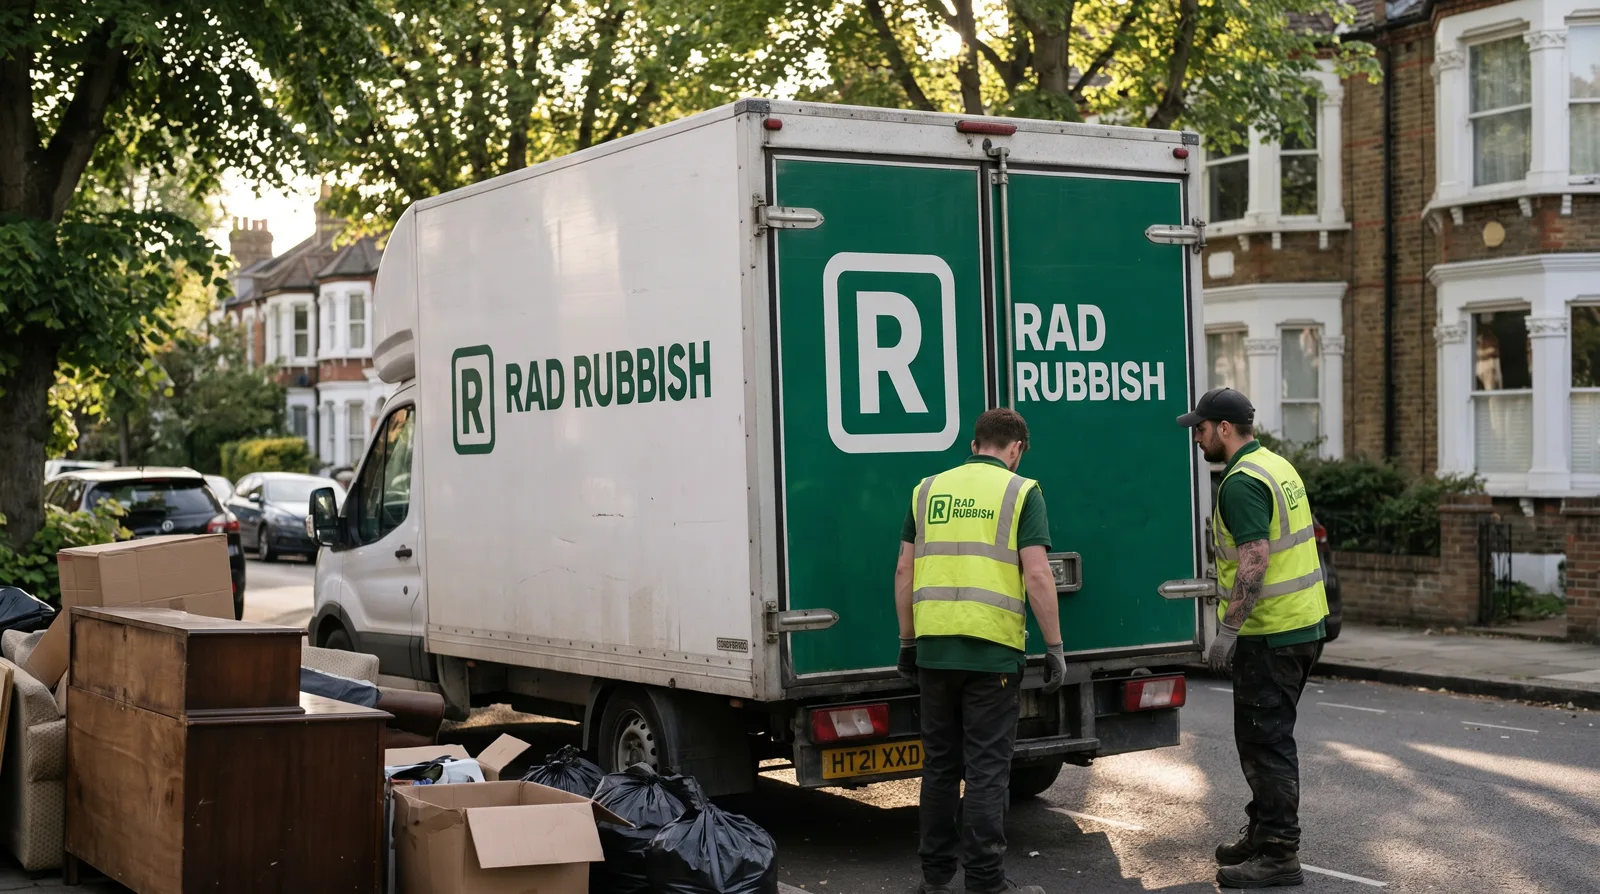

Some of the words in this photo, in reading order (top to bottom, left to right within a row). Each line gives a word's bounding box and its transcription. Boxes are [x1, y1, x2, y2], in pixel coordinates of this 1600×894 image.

[1014, 302, 1106, 352] RAD
[856, 290, 929, 414] R
[461, 368, 485, 435] R
[505, 358, 566, 414] RAD
[573, 340, 712, 409] RUBBISH
[1016, 360, 1166, 402] RUBBISH
[932, 500, 946, 519] R
[952, 509, 994, 519] RUBBISH
[954, 499, 975, 507] RAD
[832, 750, 876, 773] HT21
[882, 745, 920, 768] XXD
